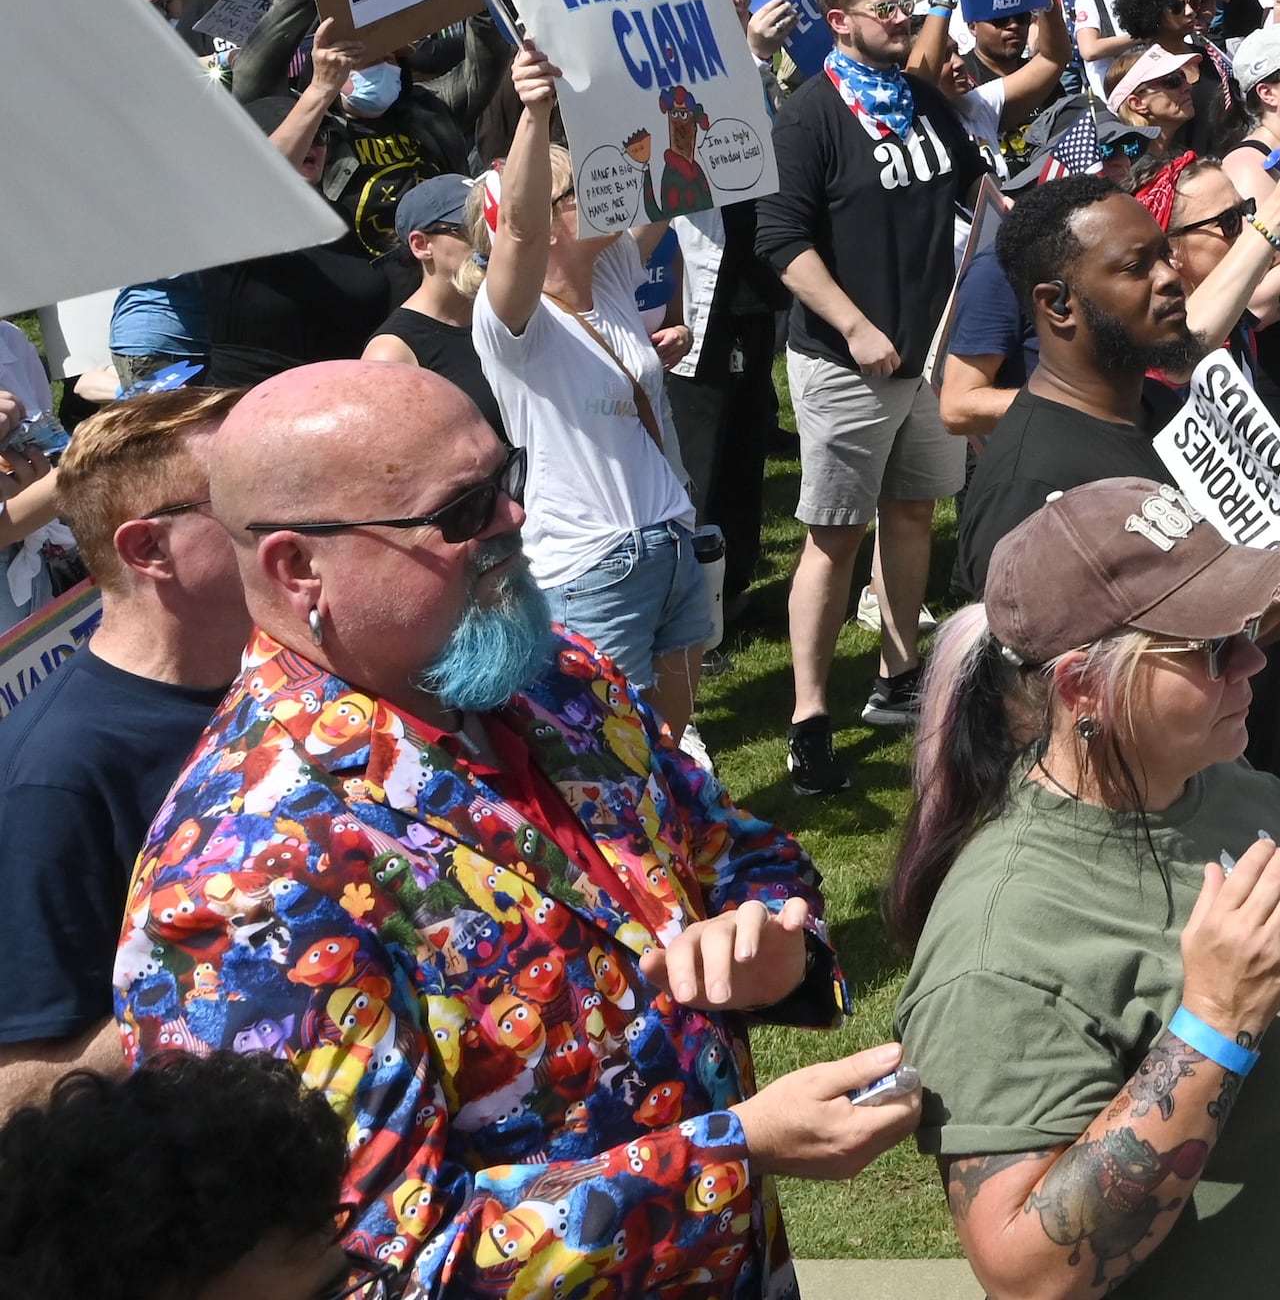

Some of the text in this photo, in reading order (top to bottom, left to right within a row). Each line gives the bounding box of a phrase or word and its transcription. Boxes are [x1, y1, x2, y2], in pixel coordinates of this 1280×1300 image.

[612, 0, 728, 90] CLOWN
[626, 178, 637, 190] MY
[709, 152, 741, 170] Birthday
[873, 115, 953, 190] atl
[1173, 416, 1272, 546] THRONES
